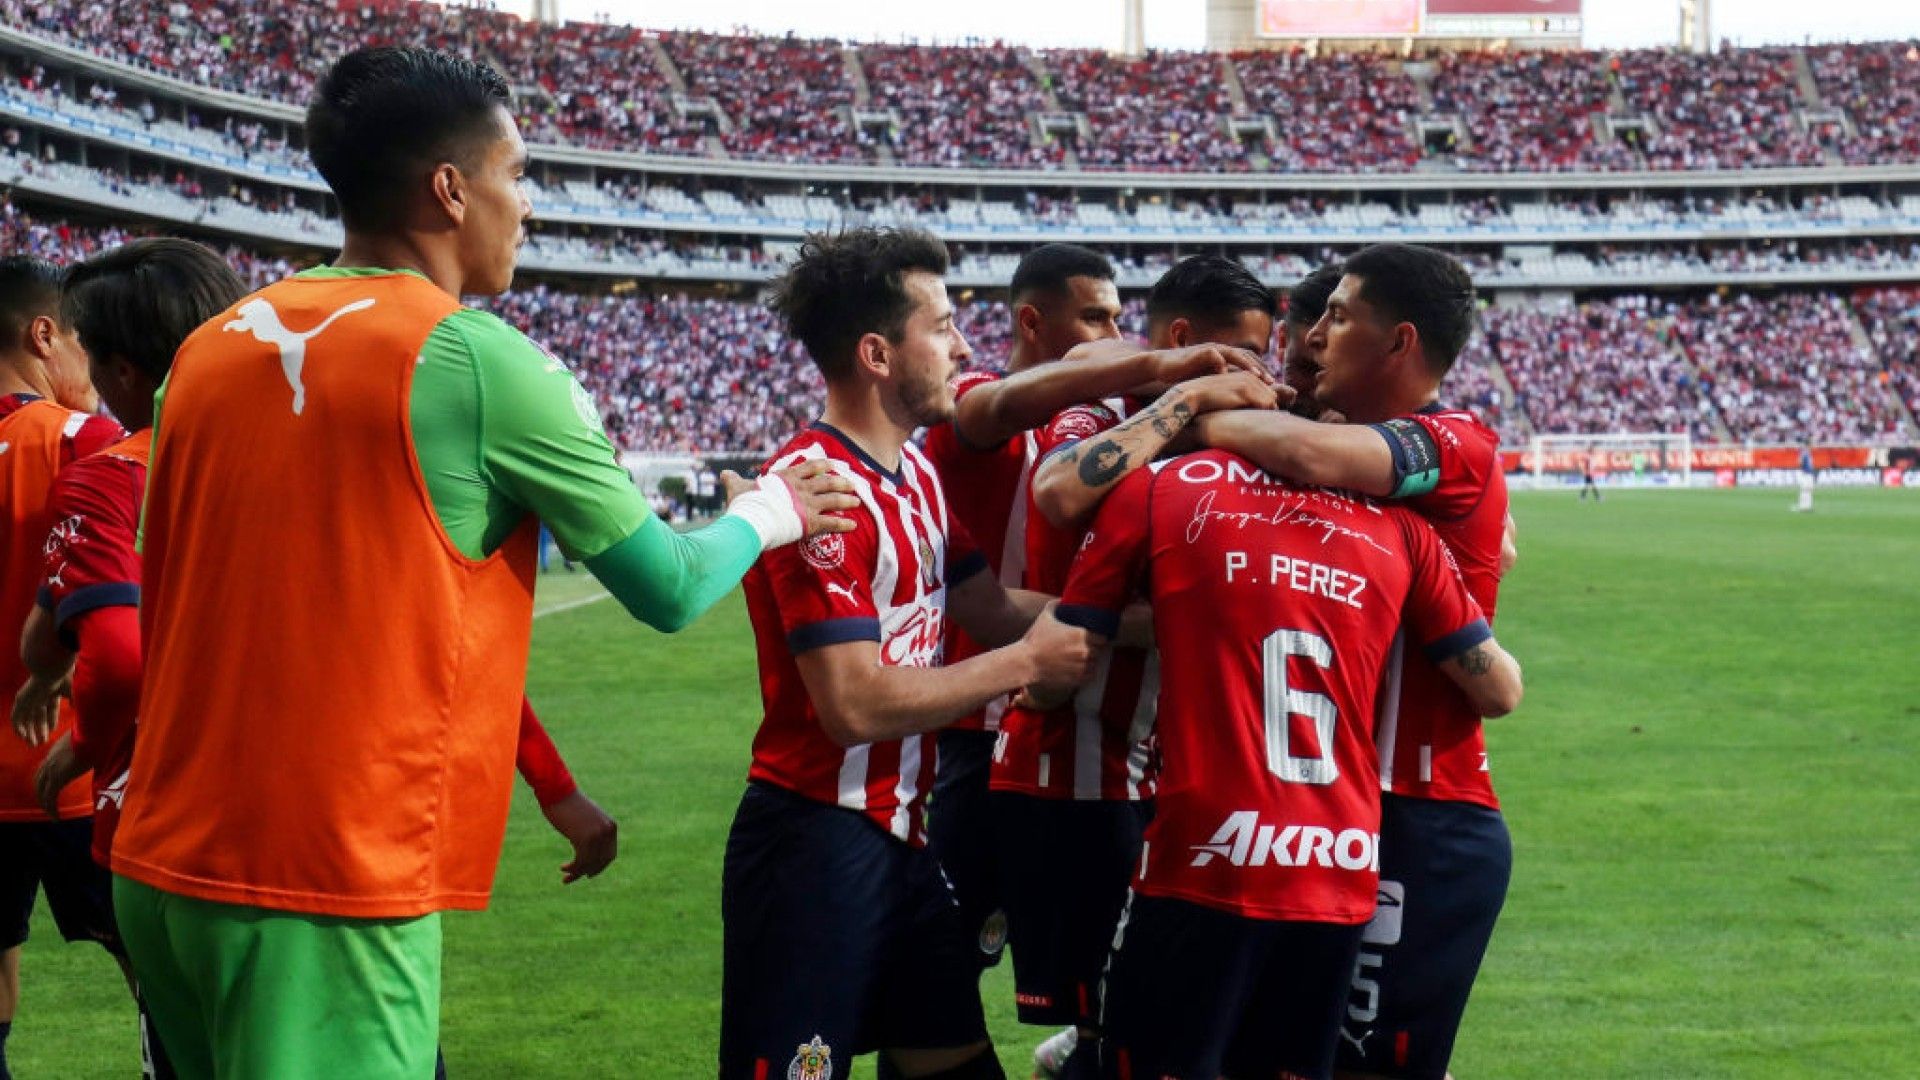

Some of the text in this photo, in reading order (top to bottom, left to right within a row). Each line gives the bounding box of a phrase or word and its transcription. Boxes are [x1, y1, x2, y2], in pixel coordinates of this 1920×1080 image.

[1225, 551, 1366, 609] P. PEREZ
[1263, 628, 1339, 785] 6
[1347, 952, 1383, 1022] 5
